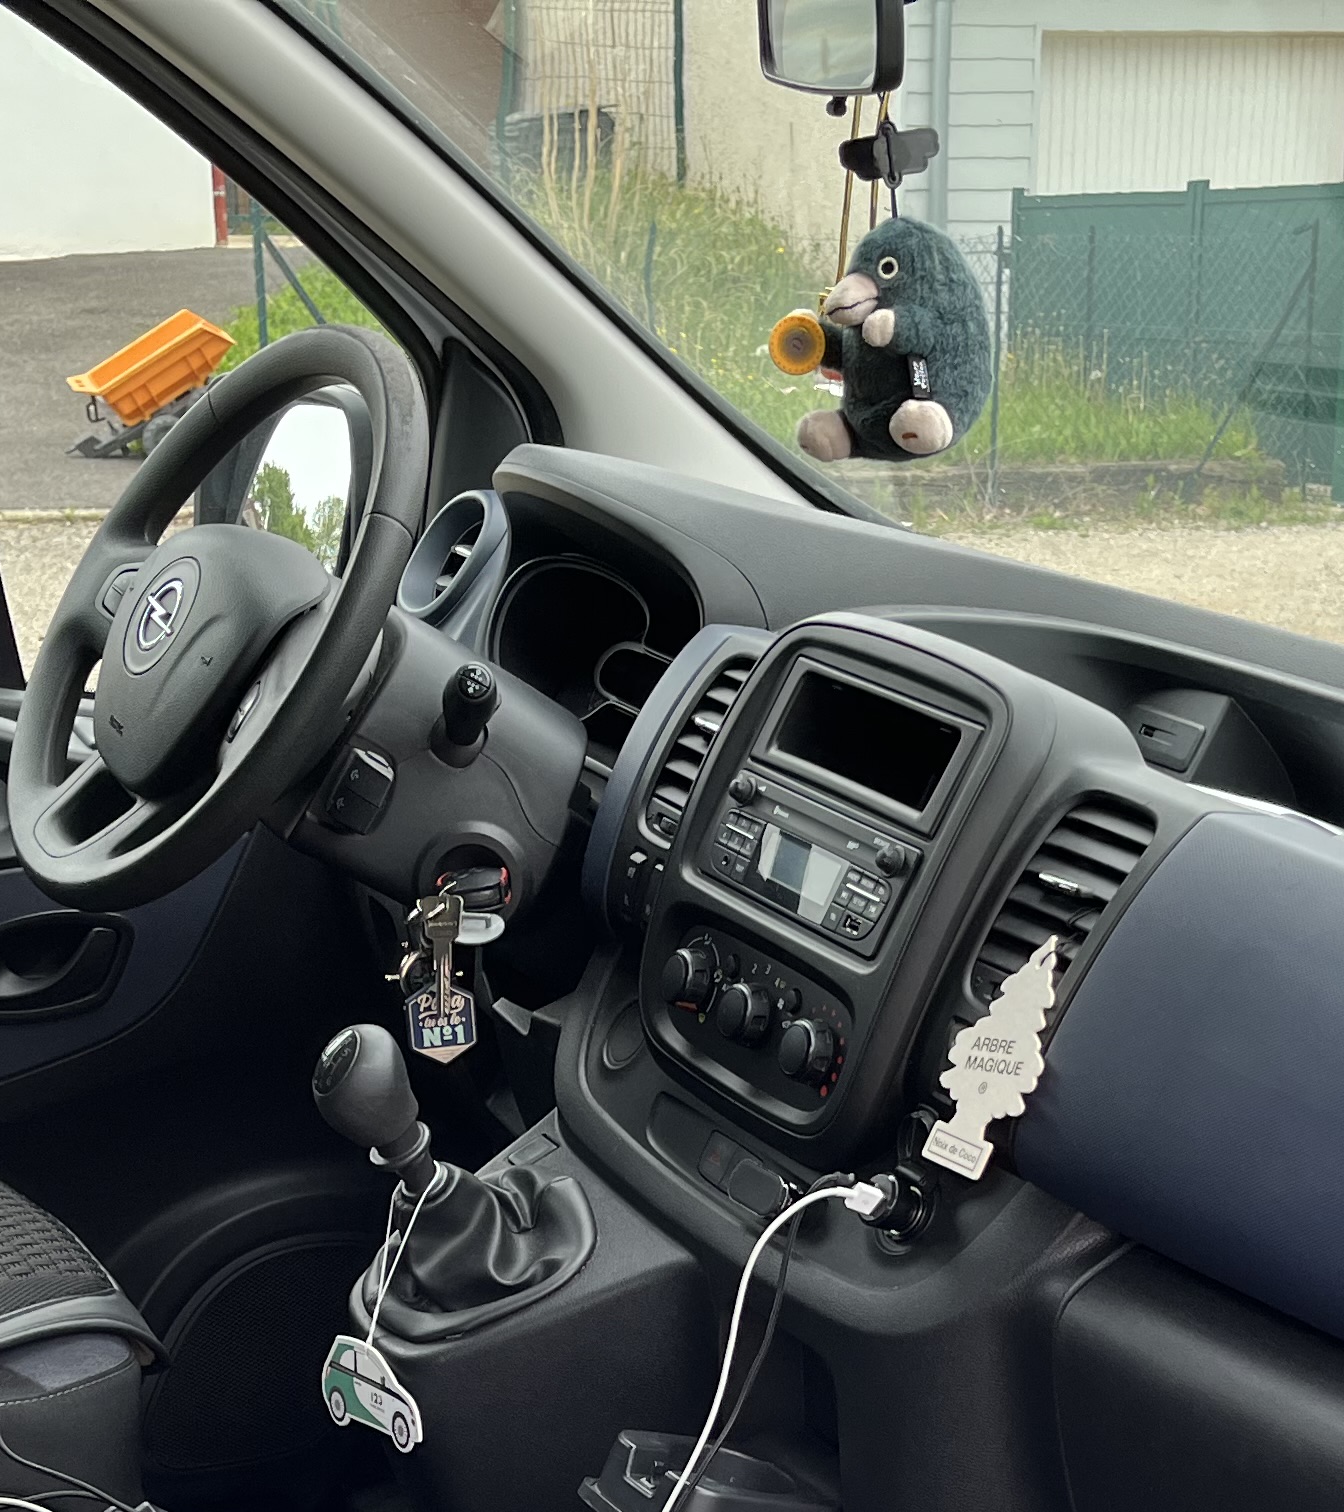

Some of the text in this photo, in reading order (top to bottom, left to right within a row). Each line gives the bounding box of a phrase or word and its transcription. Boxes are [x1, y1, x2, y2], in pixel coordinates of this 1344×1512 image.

[971, 1036, 1016, 1055] ARBRE
[964, 1056, 1024, 1076] MAGIQUE
[932, 1137, 976, 1163] Noix de Coco
